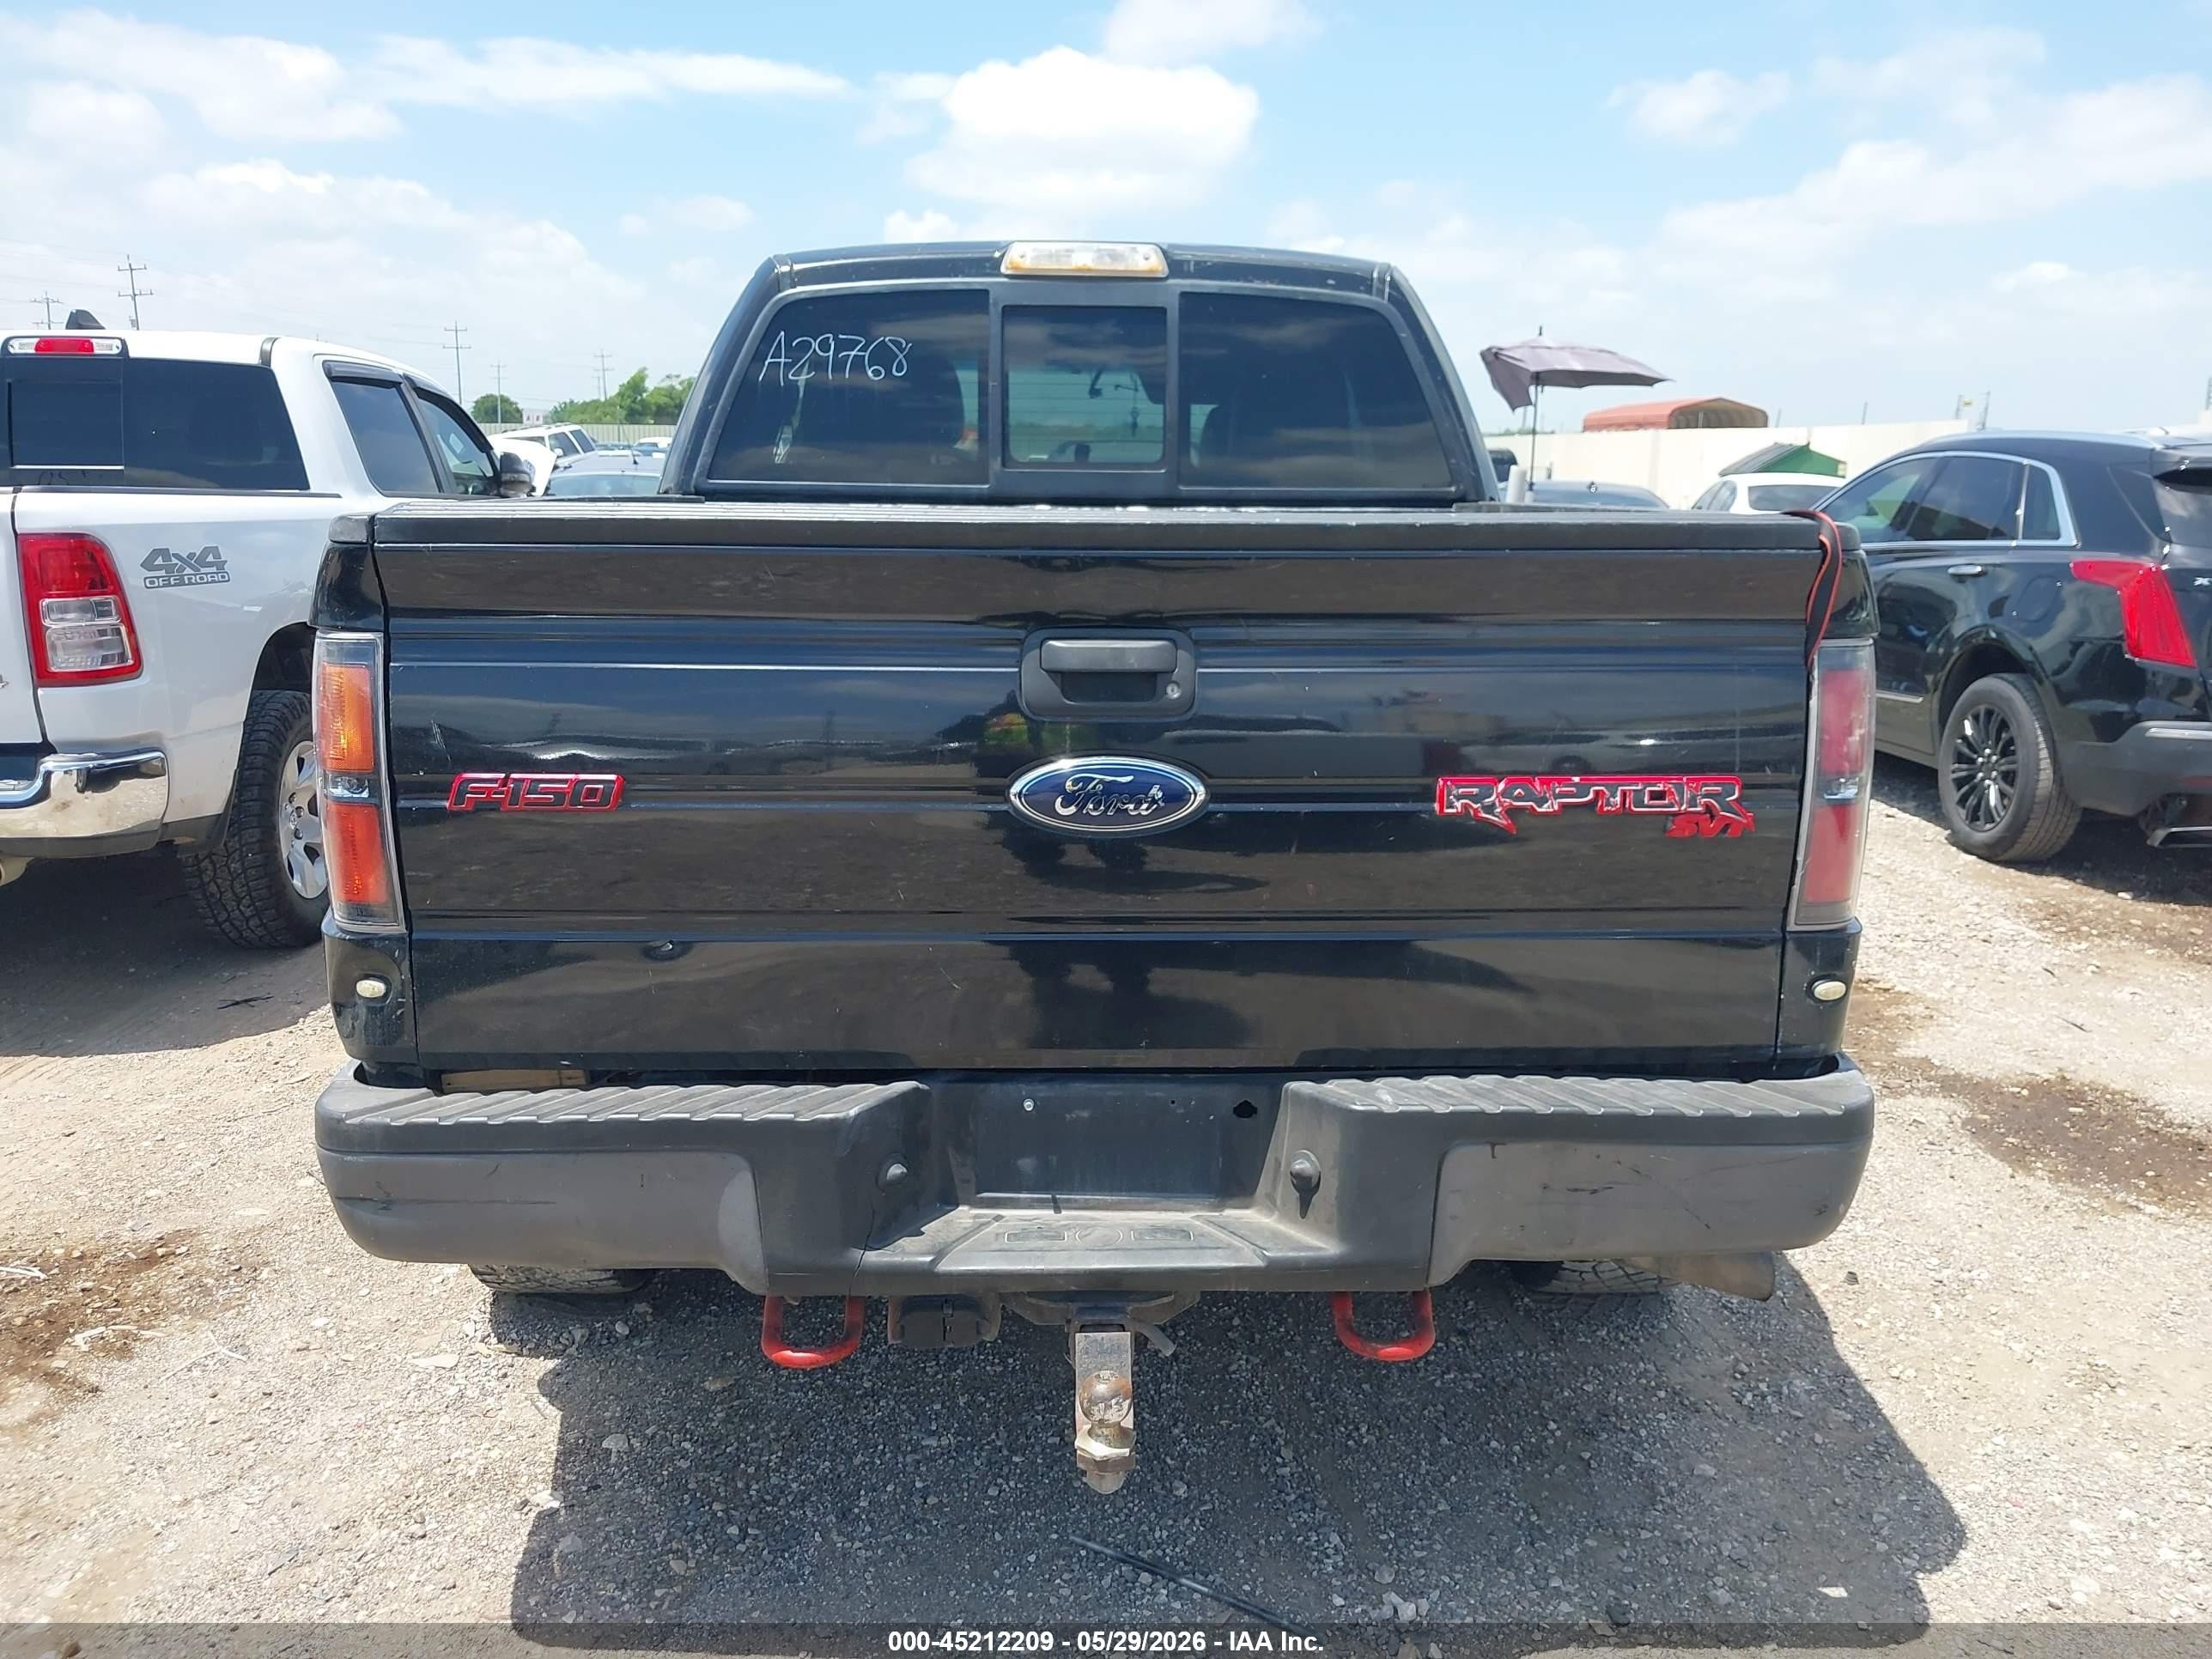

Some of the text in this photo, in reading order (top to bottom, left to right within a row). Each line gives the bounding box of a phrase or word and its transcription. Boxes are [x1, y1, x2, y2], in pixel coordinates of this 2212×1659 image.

[757, 330, 914, 386] A29768
[144, 572, 229, 588] OFF ROAD
[1054, 773, 1165, 816] Ford
[1435, 775, 1752, 835] RAPTOR
[1665, 812, 1755, 838] SVT
